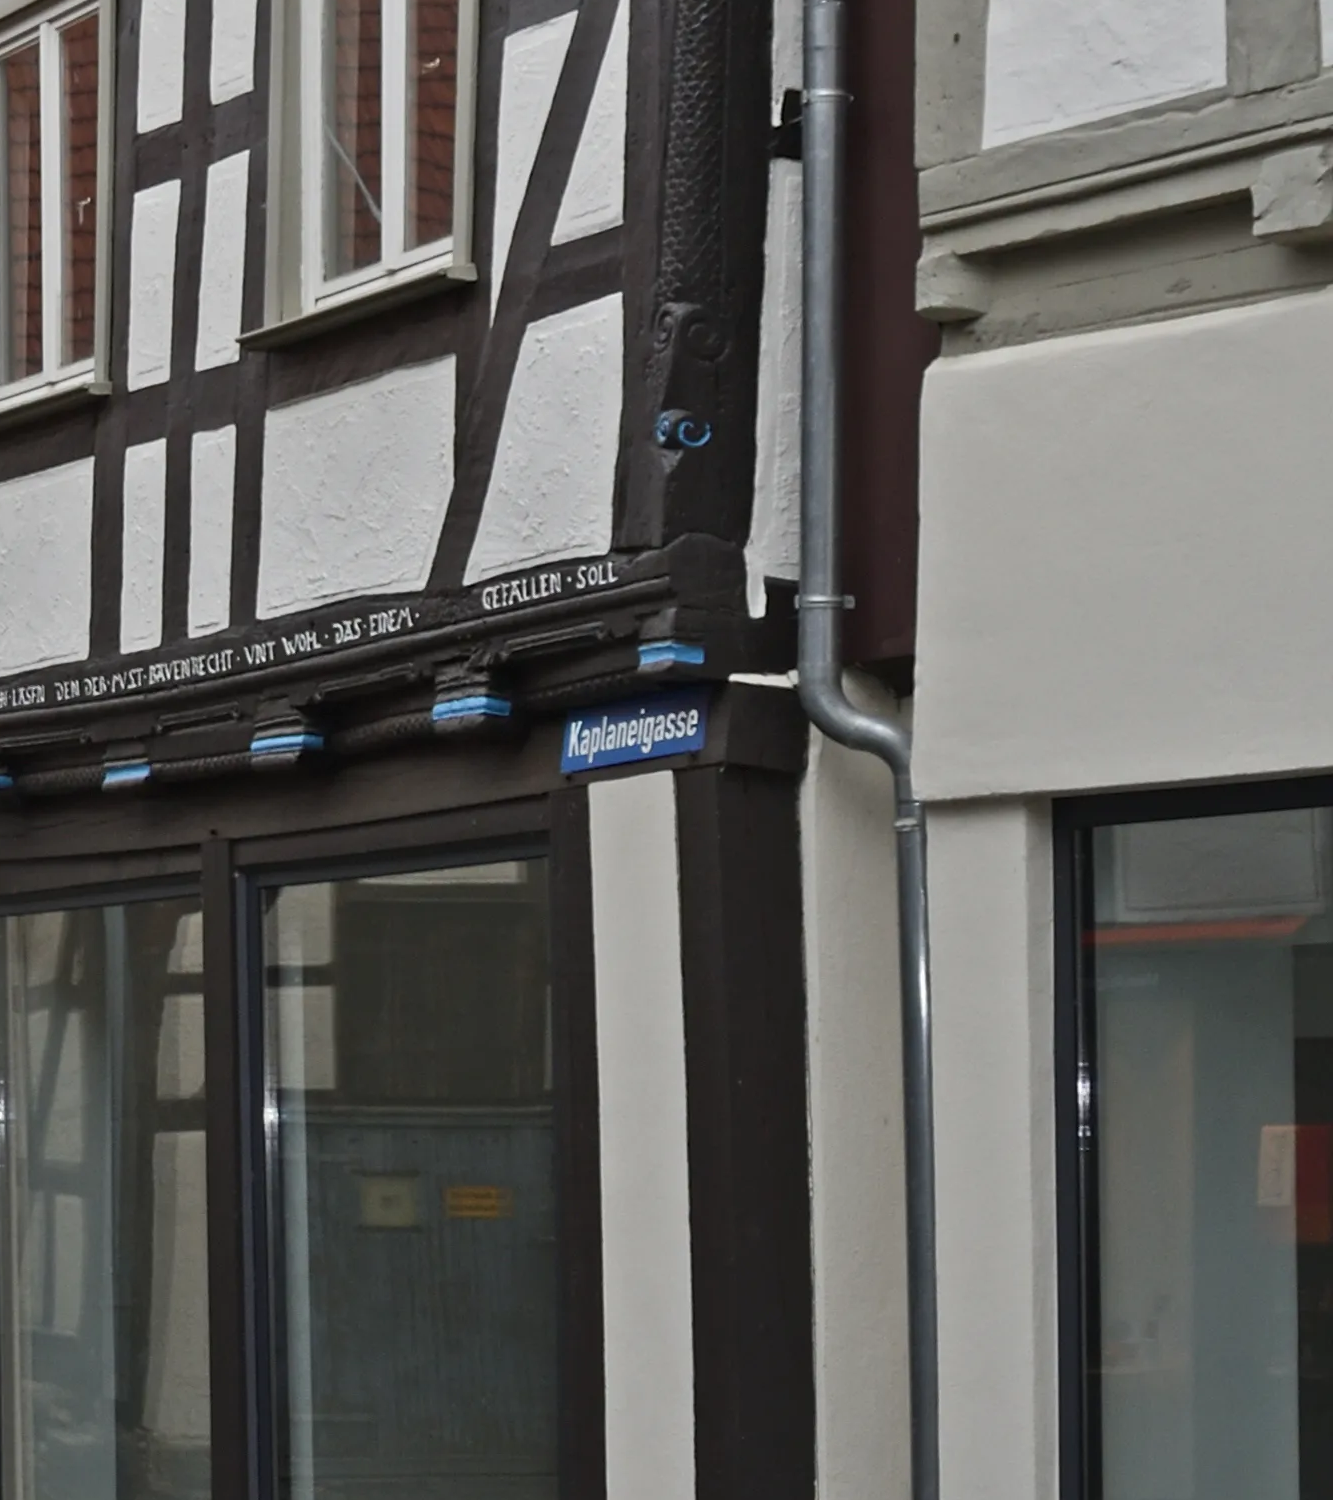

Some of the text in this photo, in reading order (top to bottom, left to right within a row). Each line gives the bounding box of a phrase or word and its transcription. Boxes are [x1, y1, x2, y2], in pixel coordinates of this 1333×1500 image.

[481, 571, 562, 611] GEFALLEN
[576, 562, 619, 591] SOLL
[567, 708, 700, 764] Kaplaneigasse
